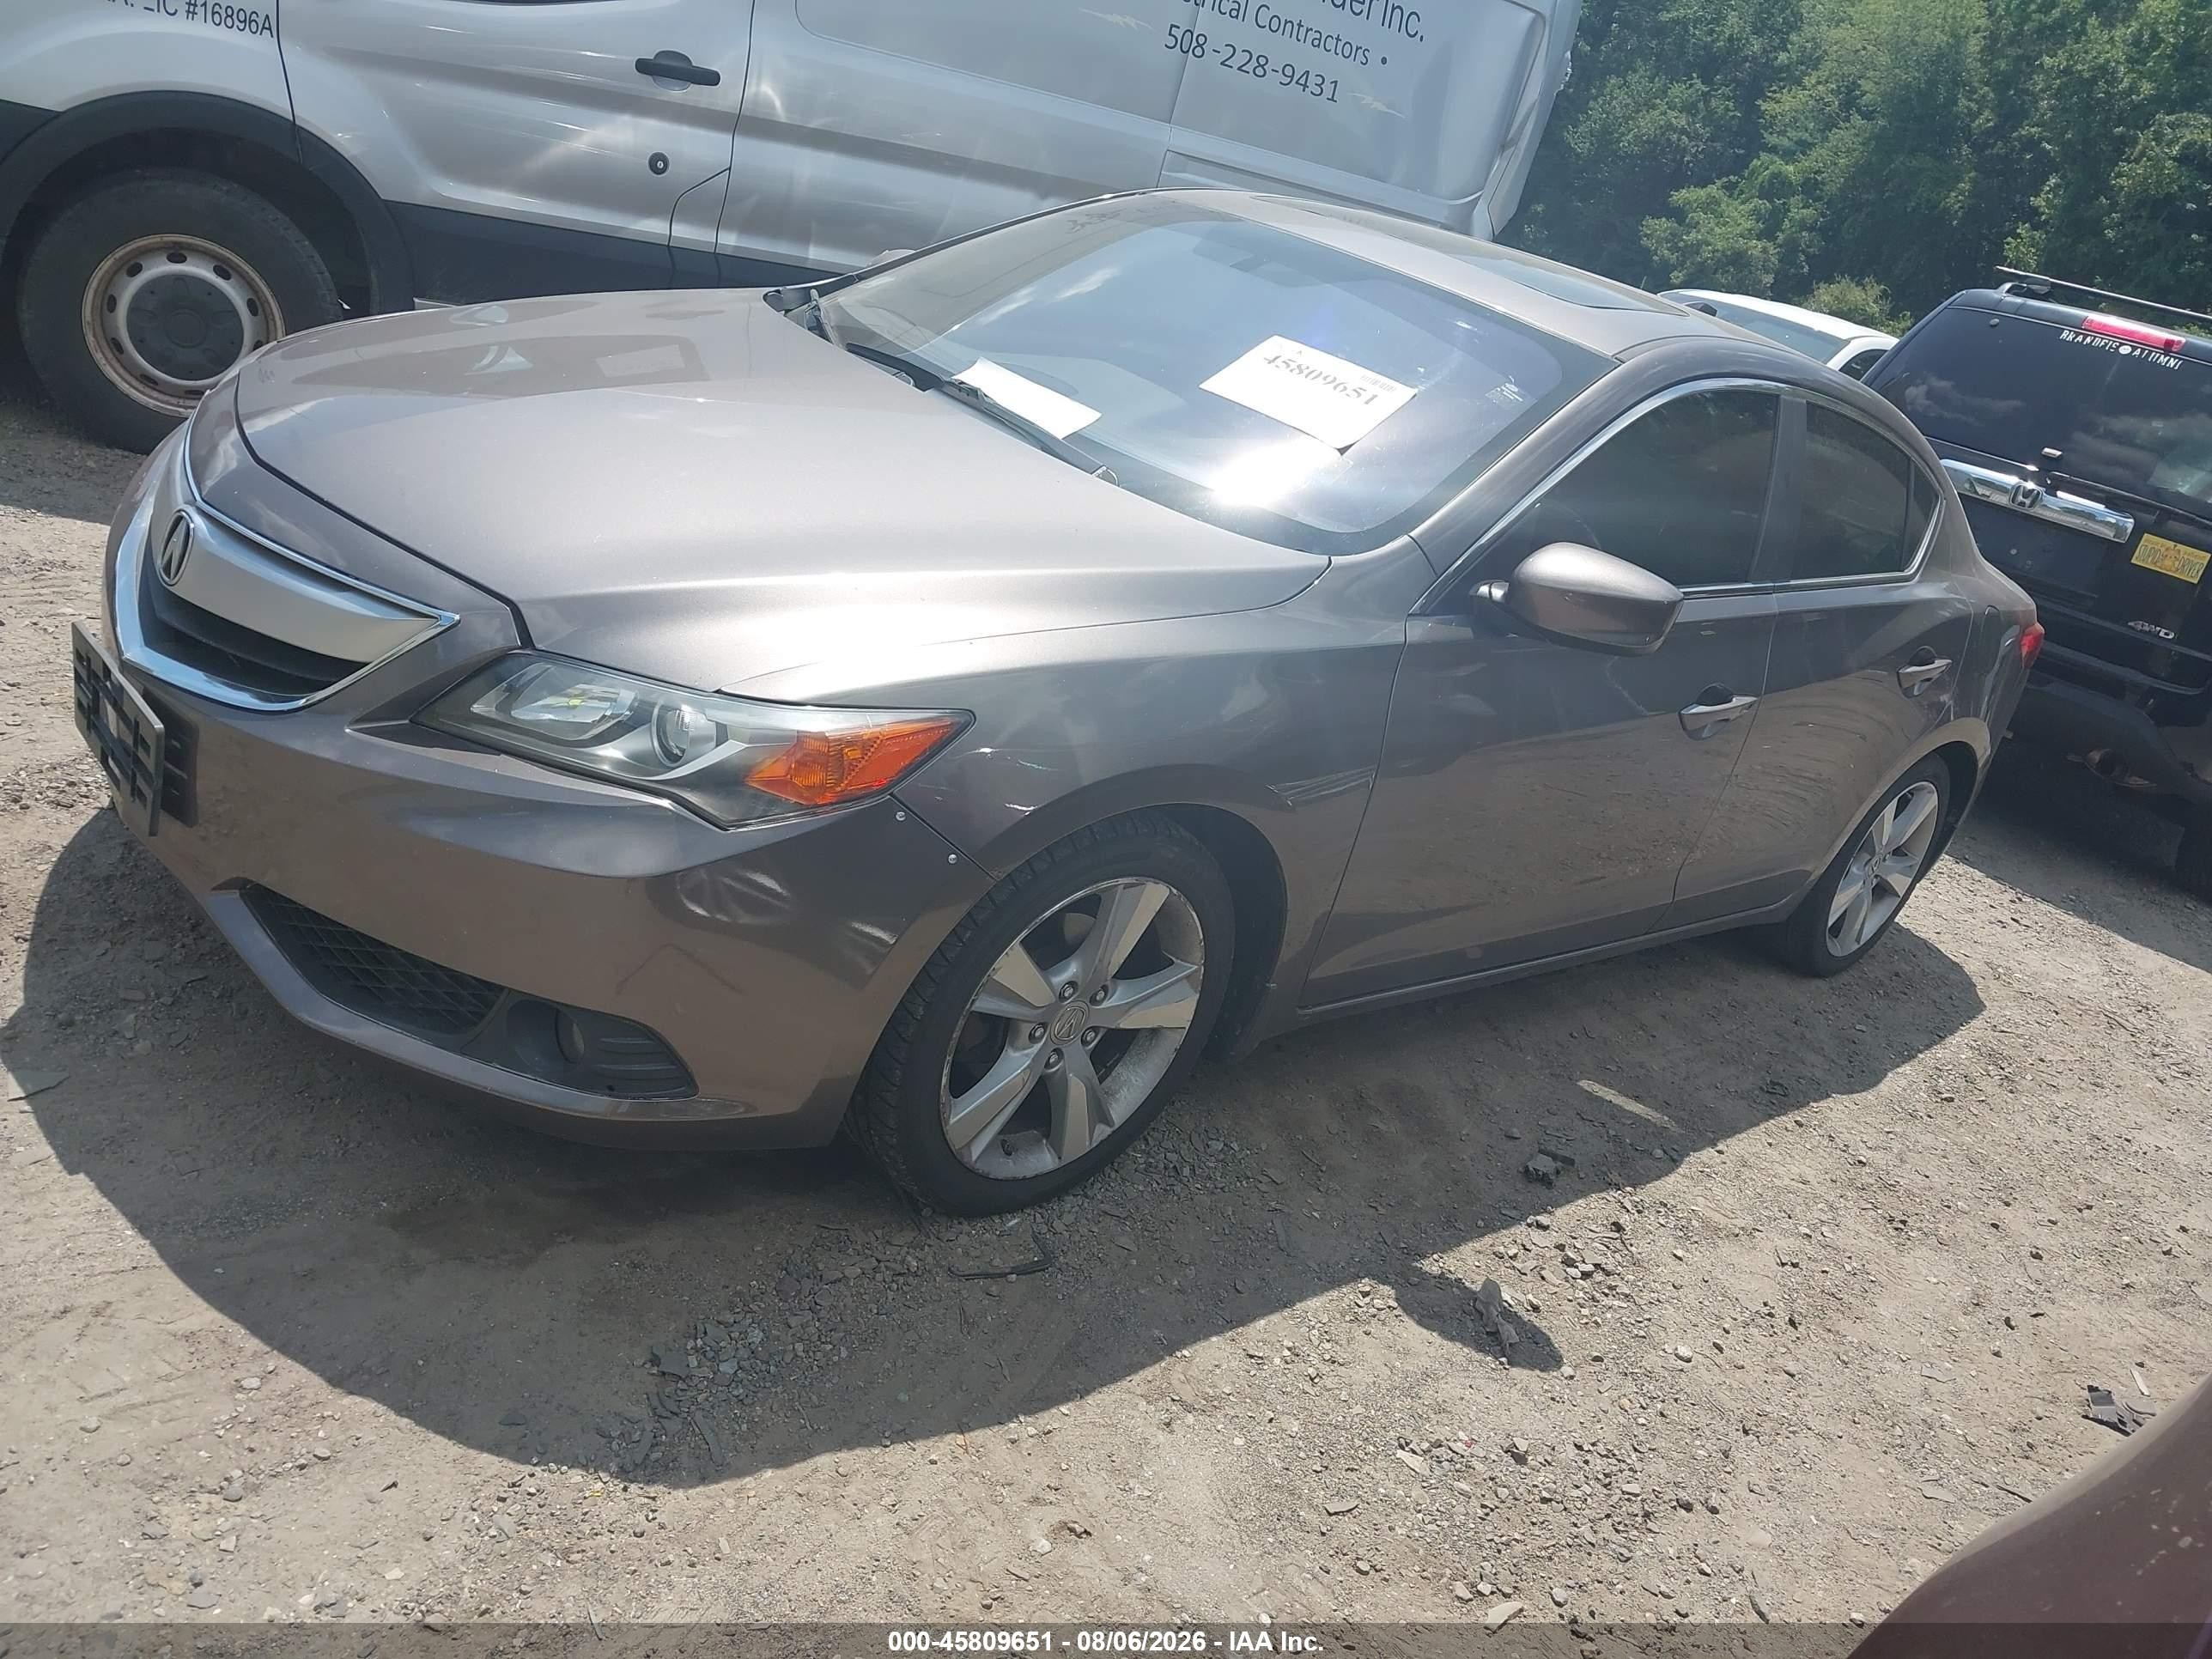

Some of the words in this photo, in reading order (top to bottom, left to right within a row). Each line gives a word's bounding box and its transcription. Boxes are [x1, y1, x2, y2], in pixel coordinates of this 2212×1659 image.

[185, 0, 274, 38] #16896A
[1255, 3, 1370, 66] Contractors
[1381, 0, 1424, 42] Inc.
[1164, 23, 1339, 103] 508-228-9431
[1263, 355, 1378, 405] 45809651
